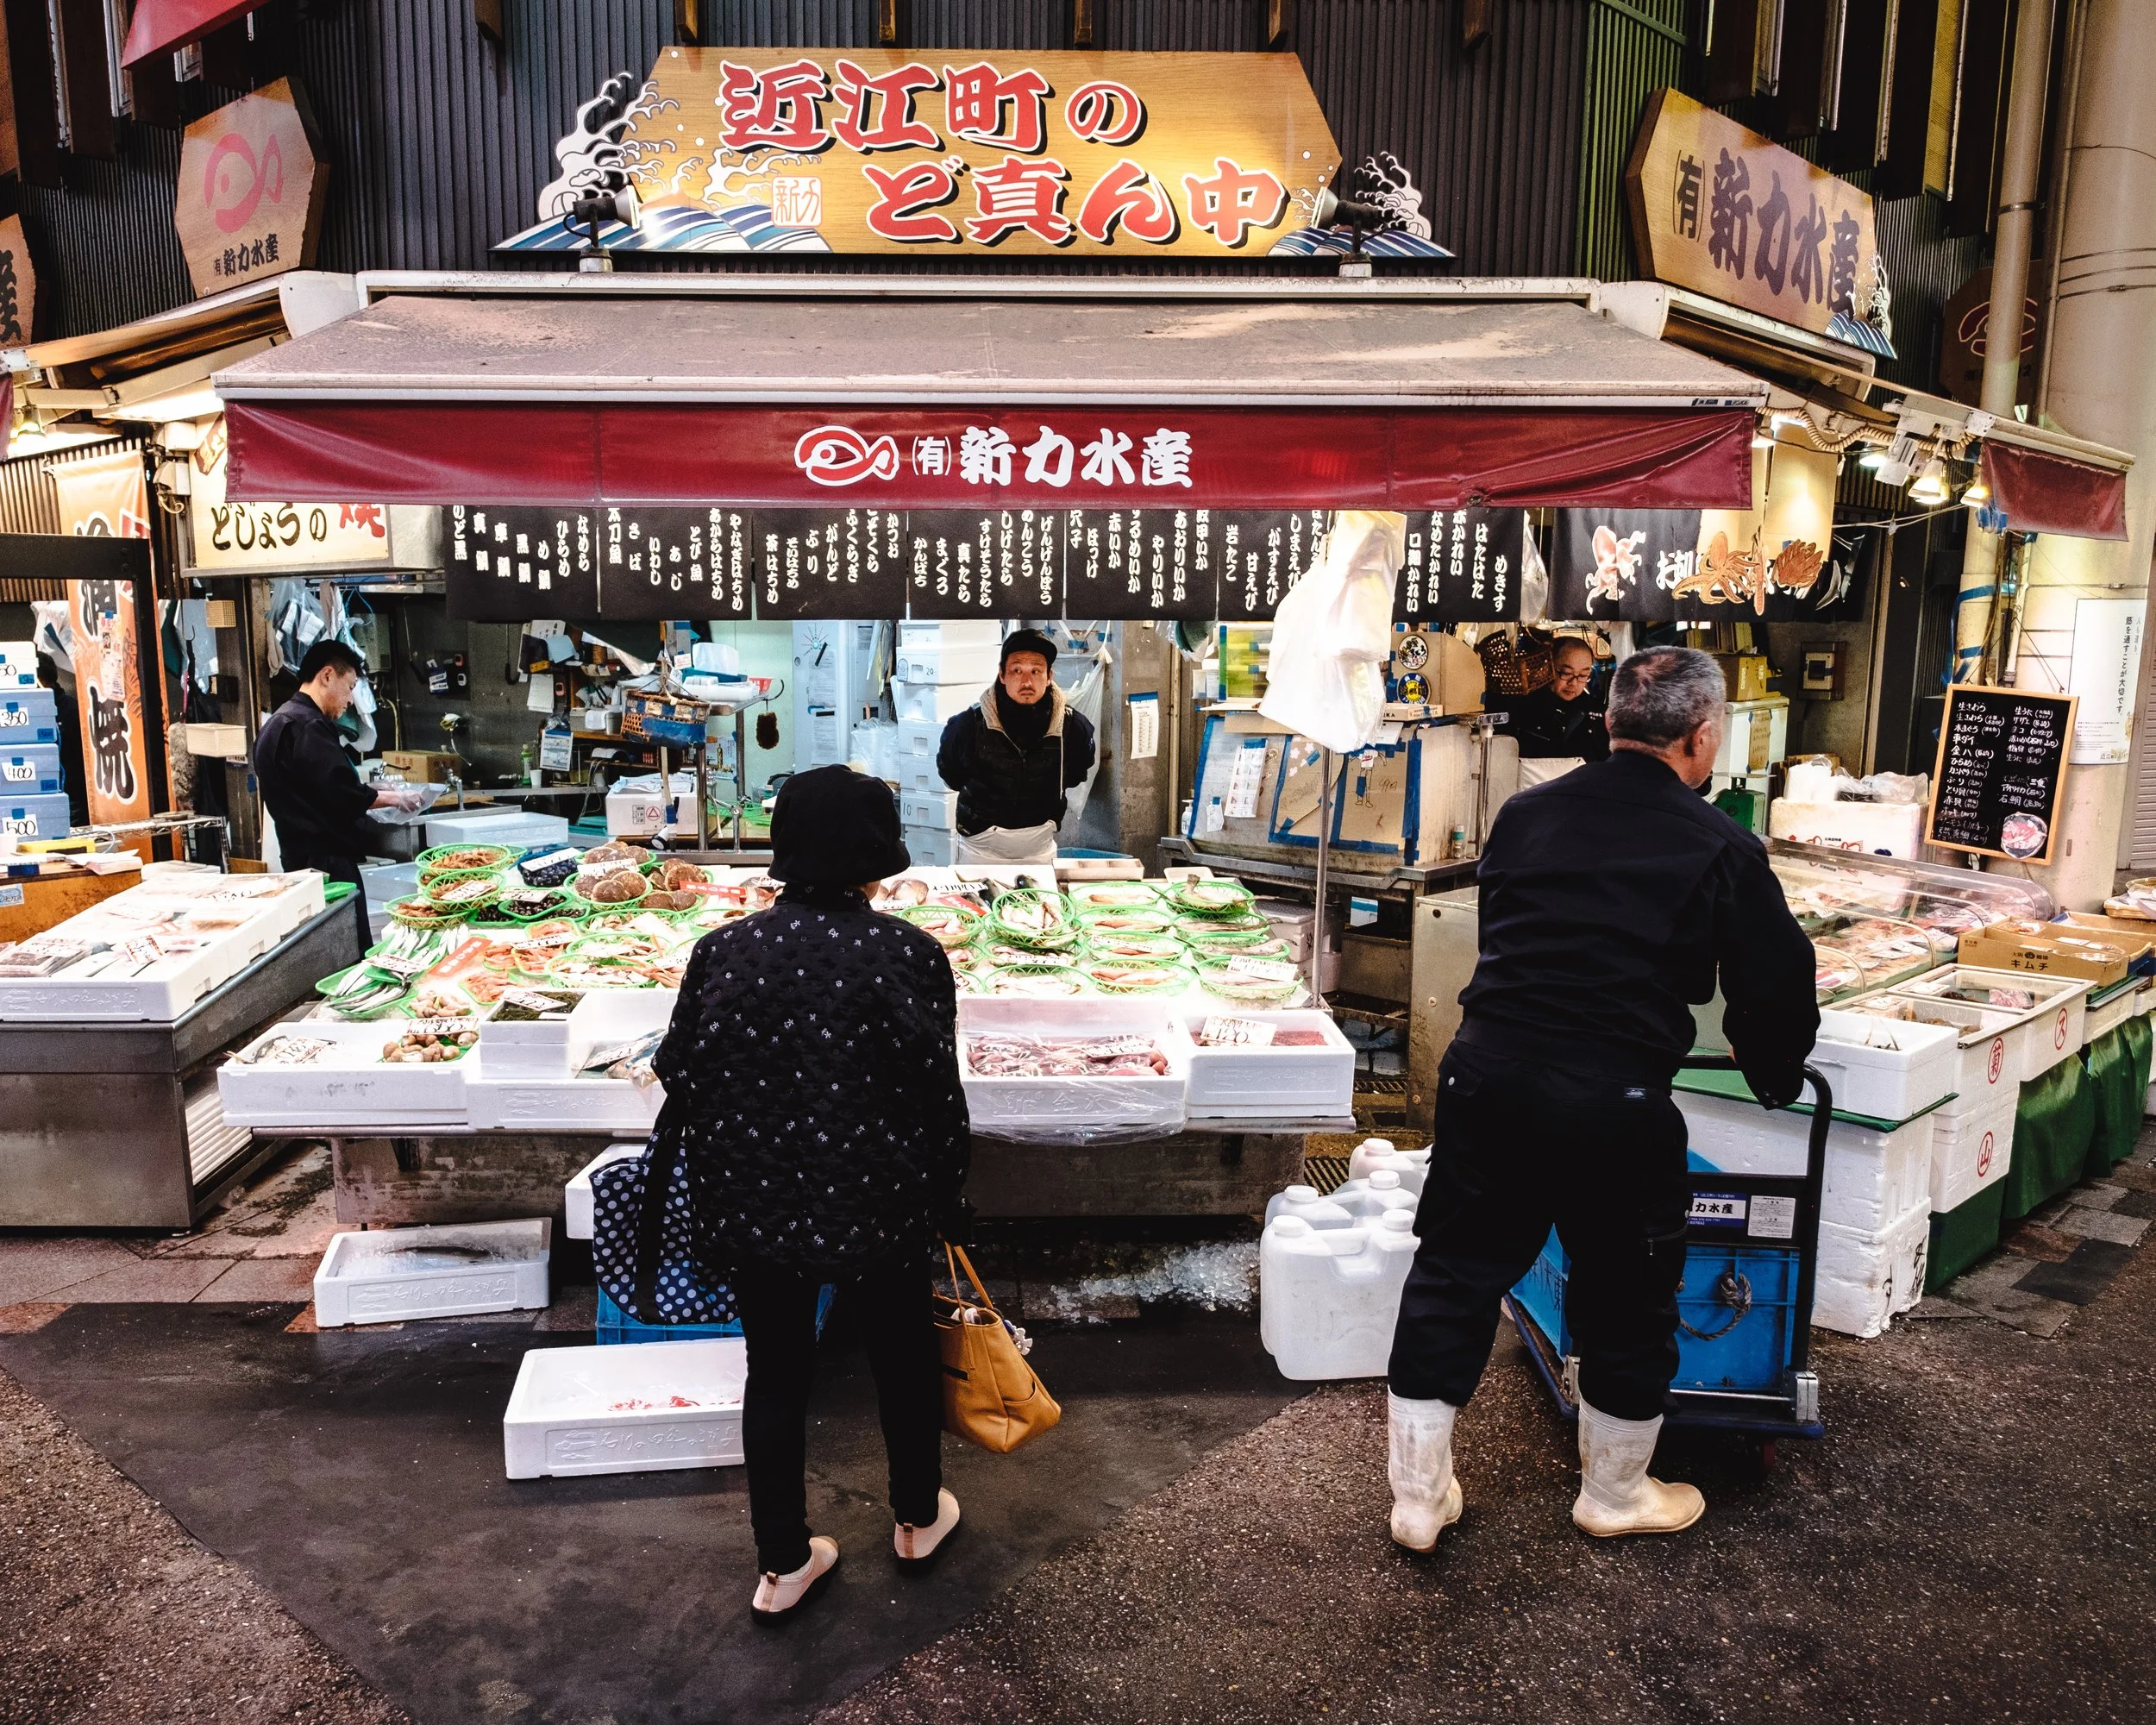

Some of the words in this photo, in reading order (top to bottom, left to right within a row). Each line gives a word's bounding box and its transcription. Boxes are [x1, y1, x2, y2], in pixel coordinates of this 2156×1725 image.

[719, 60, 1147, 153] 近江町の
[862, 156, 1290, 248] ど真ん中
[556, 520, 571, 577] ひらめ
[577, 515, 590, 571] なめら
[649, 536, 661, 586] いわし
[690, 526, 703, 581] とび魚
[826, 524, 838, 581] がんど
[887, 513, 899, 559] かつお
[1087, 528, 1100, 579] ほっけ
[1108, 512, 1121, 568] 赤いか
[1173, 510, 1187, 601] あおりいか
[1225, 524, 1238, 581] 岩たこ
[1427, 511, 1443, 604] なめたかれい
[1471, 524, 1489, 599] はたはた
[936, 537, 949, 595] まぐろ
[957, 543, 971, 603] 真たら
[1151, 535, 1164, 608] やりいか
[1245, 552, 1259, 612] 甘えび
[1266, 527, 1282, 605] がすえび
[1, 712, 27, 726] 350
[8, 765, 33, 780] 400
[7, 820, 36, 836] 500
[2011, 959, 2048, 971] キムチ
[1689, 1201, 1733, 1214] 力水産
